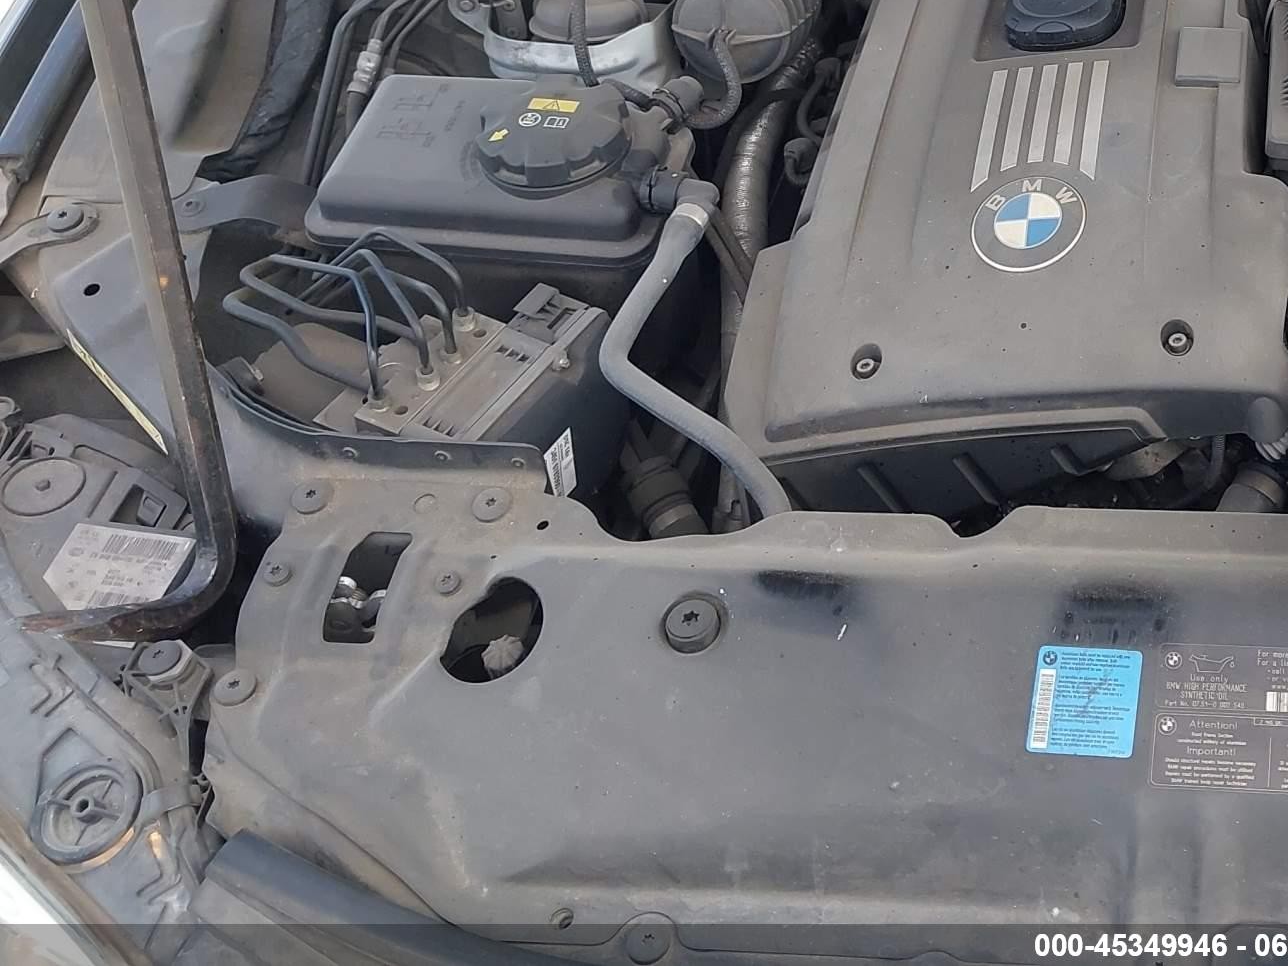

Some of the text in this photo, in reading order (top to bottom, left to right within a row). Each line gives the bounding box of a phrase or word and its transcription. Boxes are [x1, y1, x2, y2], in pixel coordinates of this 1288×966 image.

[985, 179, 1079, 212] BMW
[1258, 650, 1270, 658] For
[1190, 673, 1229, 683] Use only
[1166, 682, 1248, 692] BMW HIGH PERFORMANCE
[1181, 691, 1228, 700] SYNTHETIC OIL
[1189, 720, 1238, 730] Attention!
[1187, 746, 1236, 756] Important!
